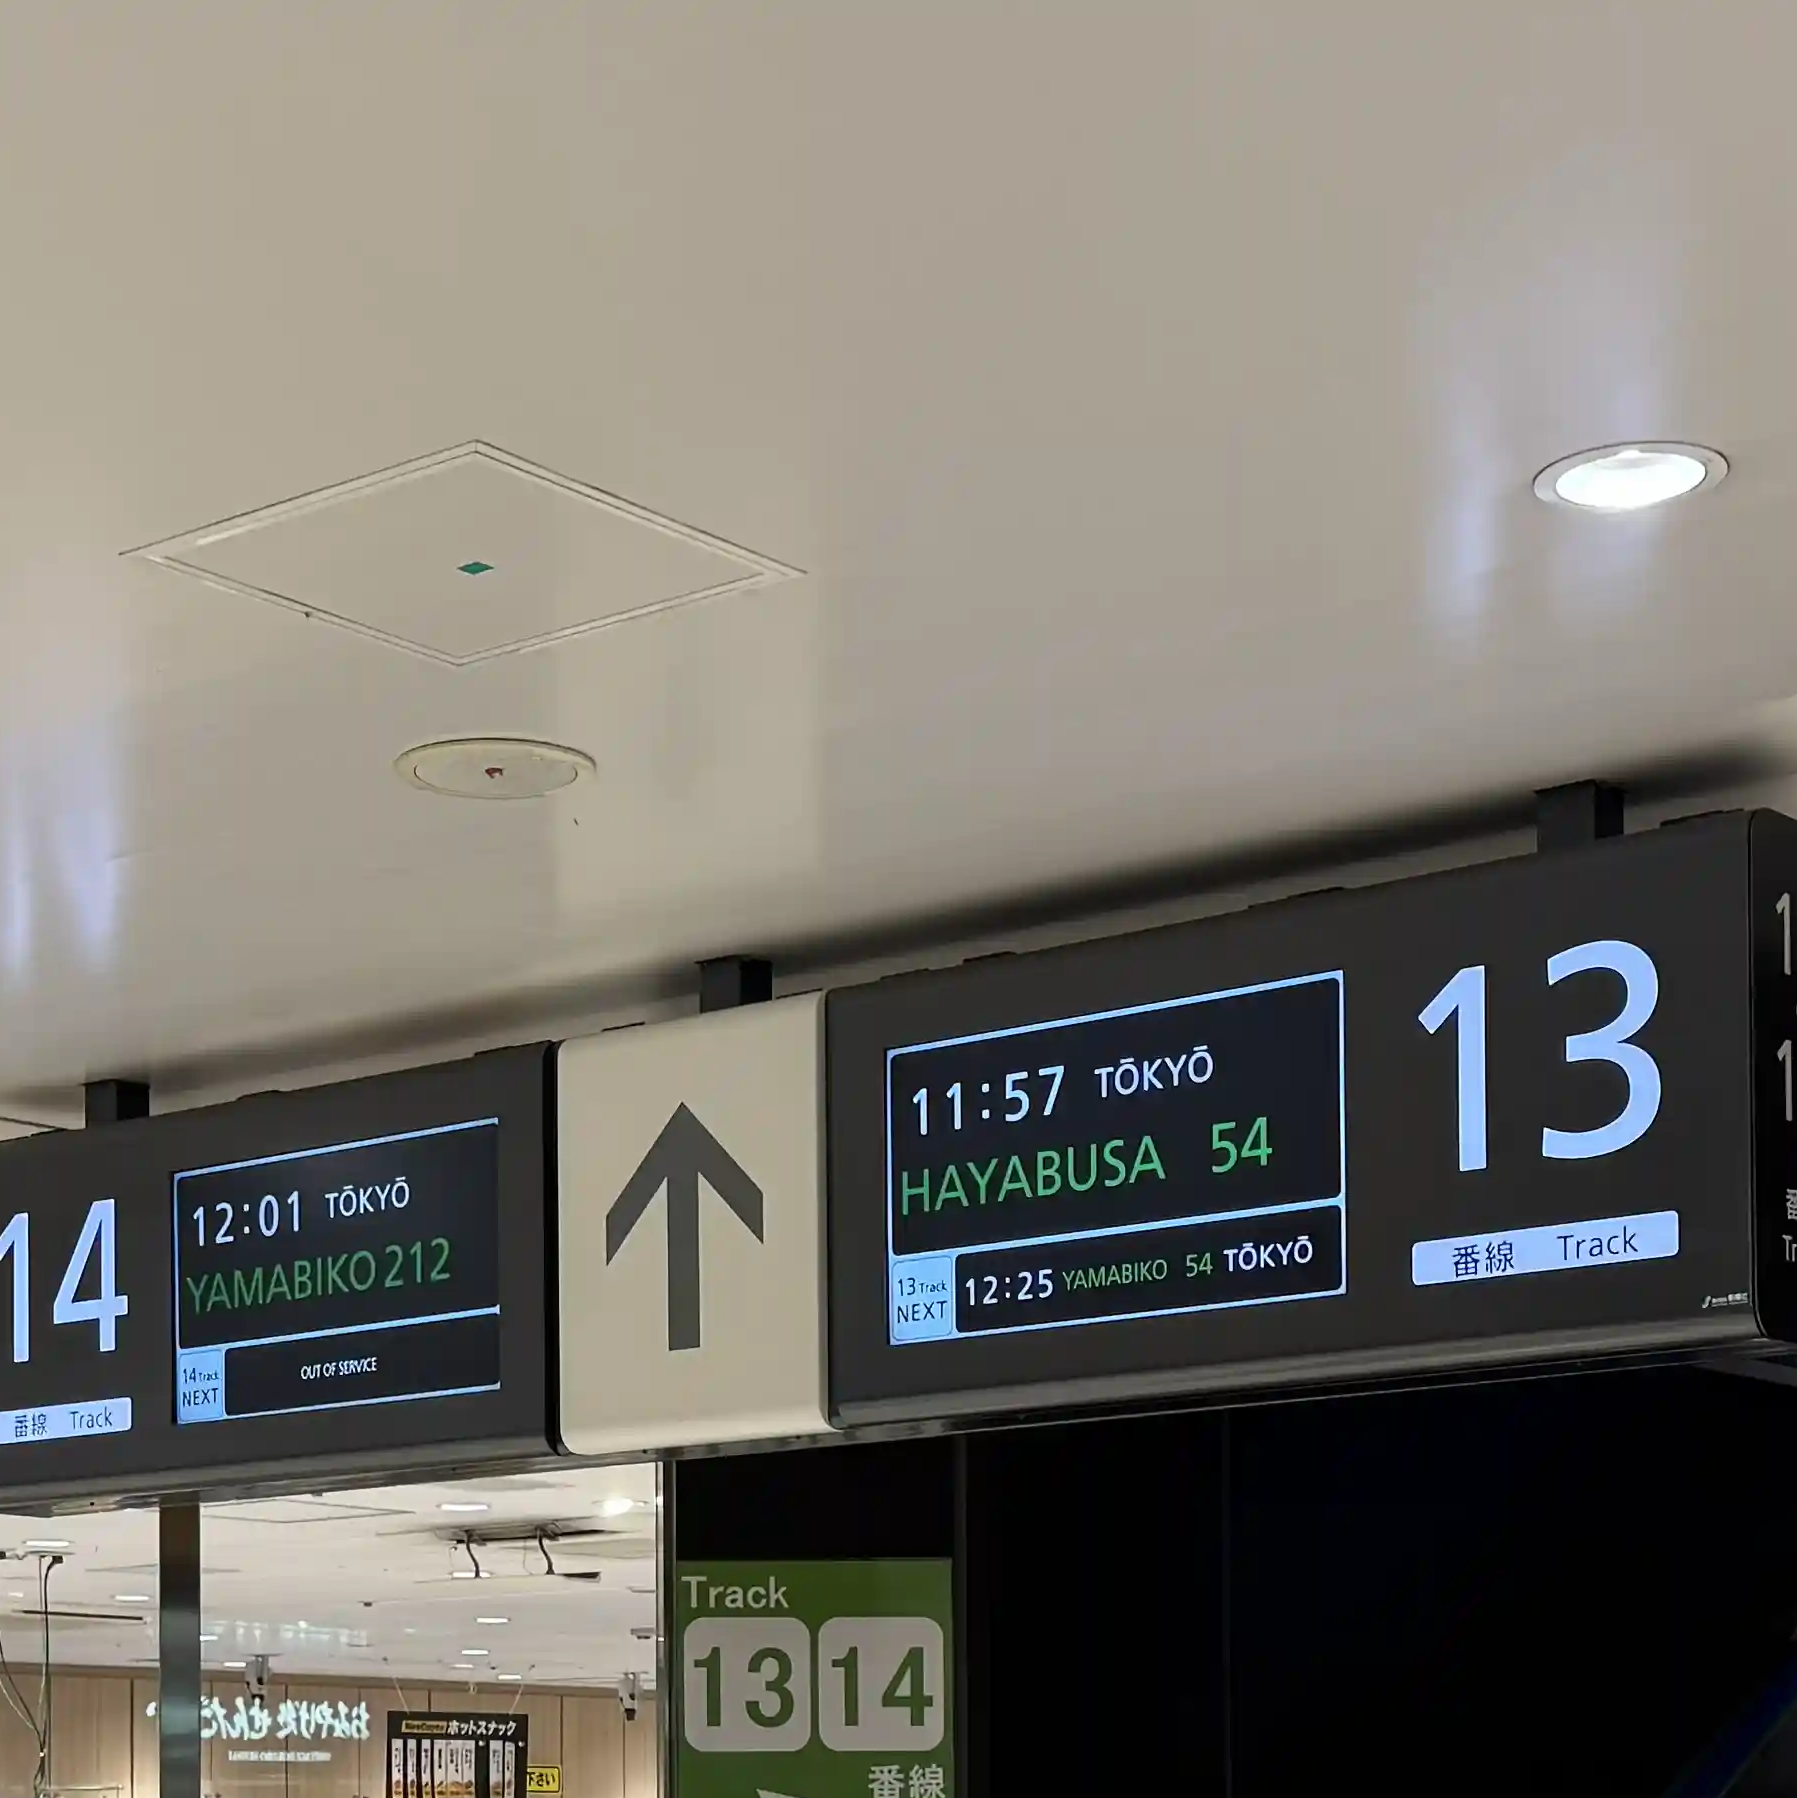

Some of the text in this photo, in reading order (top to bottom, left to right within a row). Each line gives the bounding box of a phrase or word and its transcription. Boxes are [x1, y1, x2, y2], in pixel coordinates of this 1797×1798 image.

[1418, 940, 1662, 1172] 13
[912, 1046, 1214, 1136] 11:57 TŌKYŌ
[902, 1116, 1272, 1215] HAYABUSA 54
[193, 1176, 410, 1246] 12:01 TŌKYŌ
[965, 1236, 1313, 1306] 12:25 YAMABIKO 54 TŌKYŌ
[1452, 1227, 1638, 1278] 番線 Track
[186, 1237, 451, 1315] YAMABIKO 212
[897, 1277, 947, 1295] 13 Track
[897, 1301, 947, 1324] NEXT
[182, 1368, 196, 1383] 14
[301, 1357, 377, 1379] OUT OF SERVICE
[182, 1387, 218, 1406] NEXT
[14, 1408, 113, 1438] 番線 Track
[682, 1576, 789, 1609] Track
[694, 1646, 933, 1728] 13 14
[447, 1719, 517, 1736] ホットスナック
